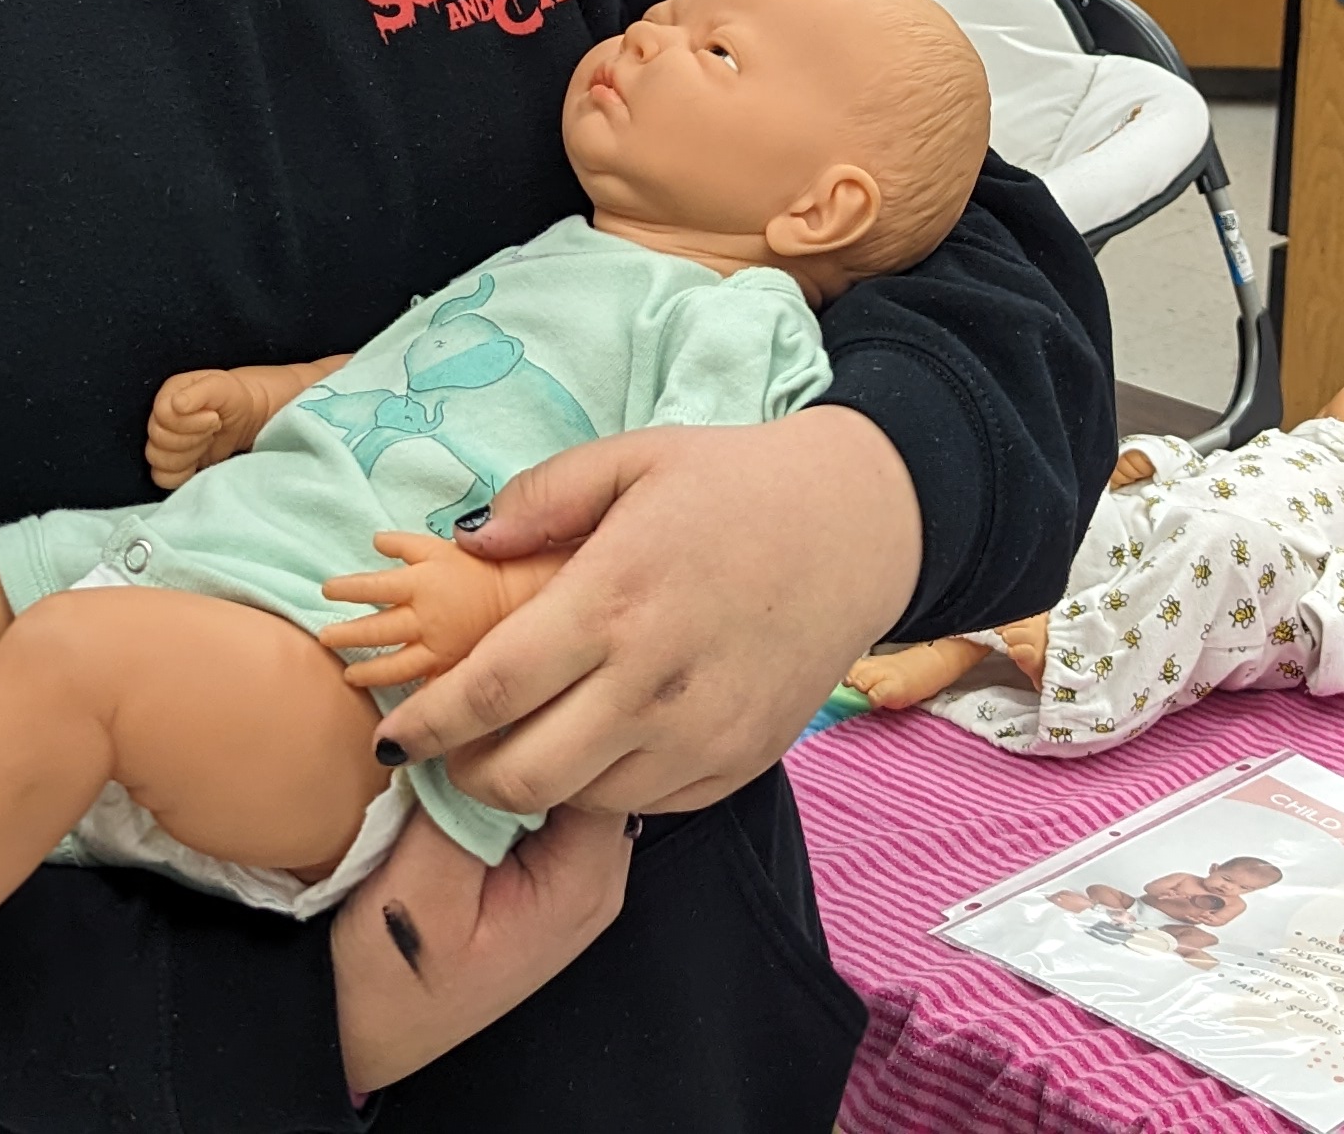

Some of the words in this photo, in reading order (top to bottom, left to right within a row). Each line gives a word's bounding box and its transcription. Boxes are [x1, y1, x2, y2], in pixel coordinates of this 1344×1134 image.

[1270, 793, 1341, 830] CHILD
[1249, 969, 1293, 989] CHILD
[1269, 957, 1320, 983] CARING
[1229, 978, 1285, 1005] FAMILY
